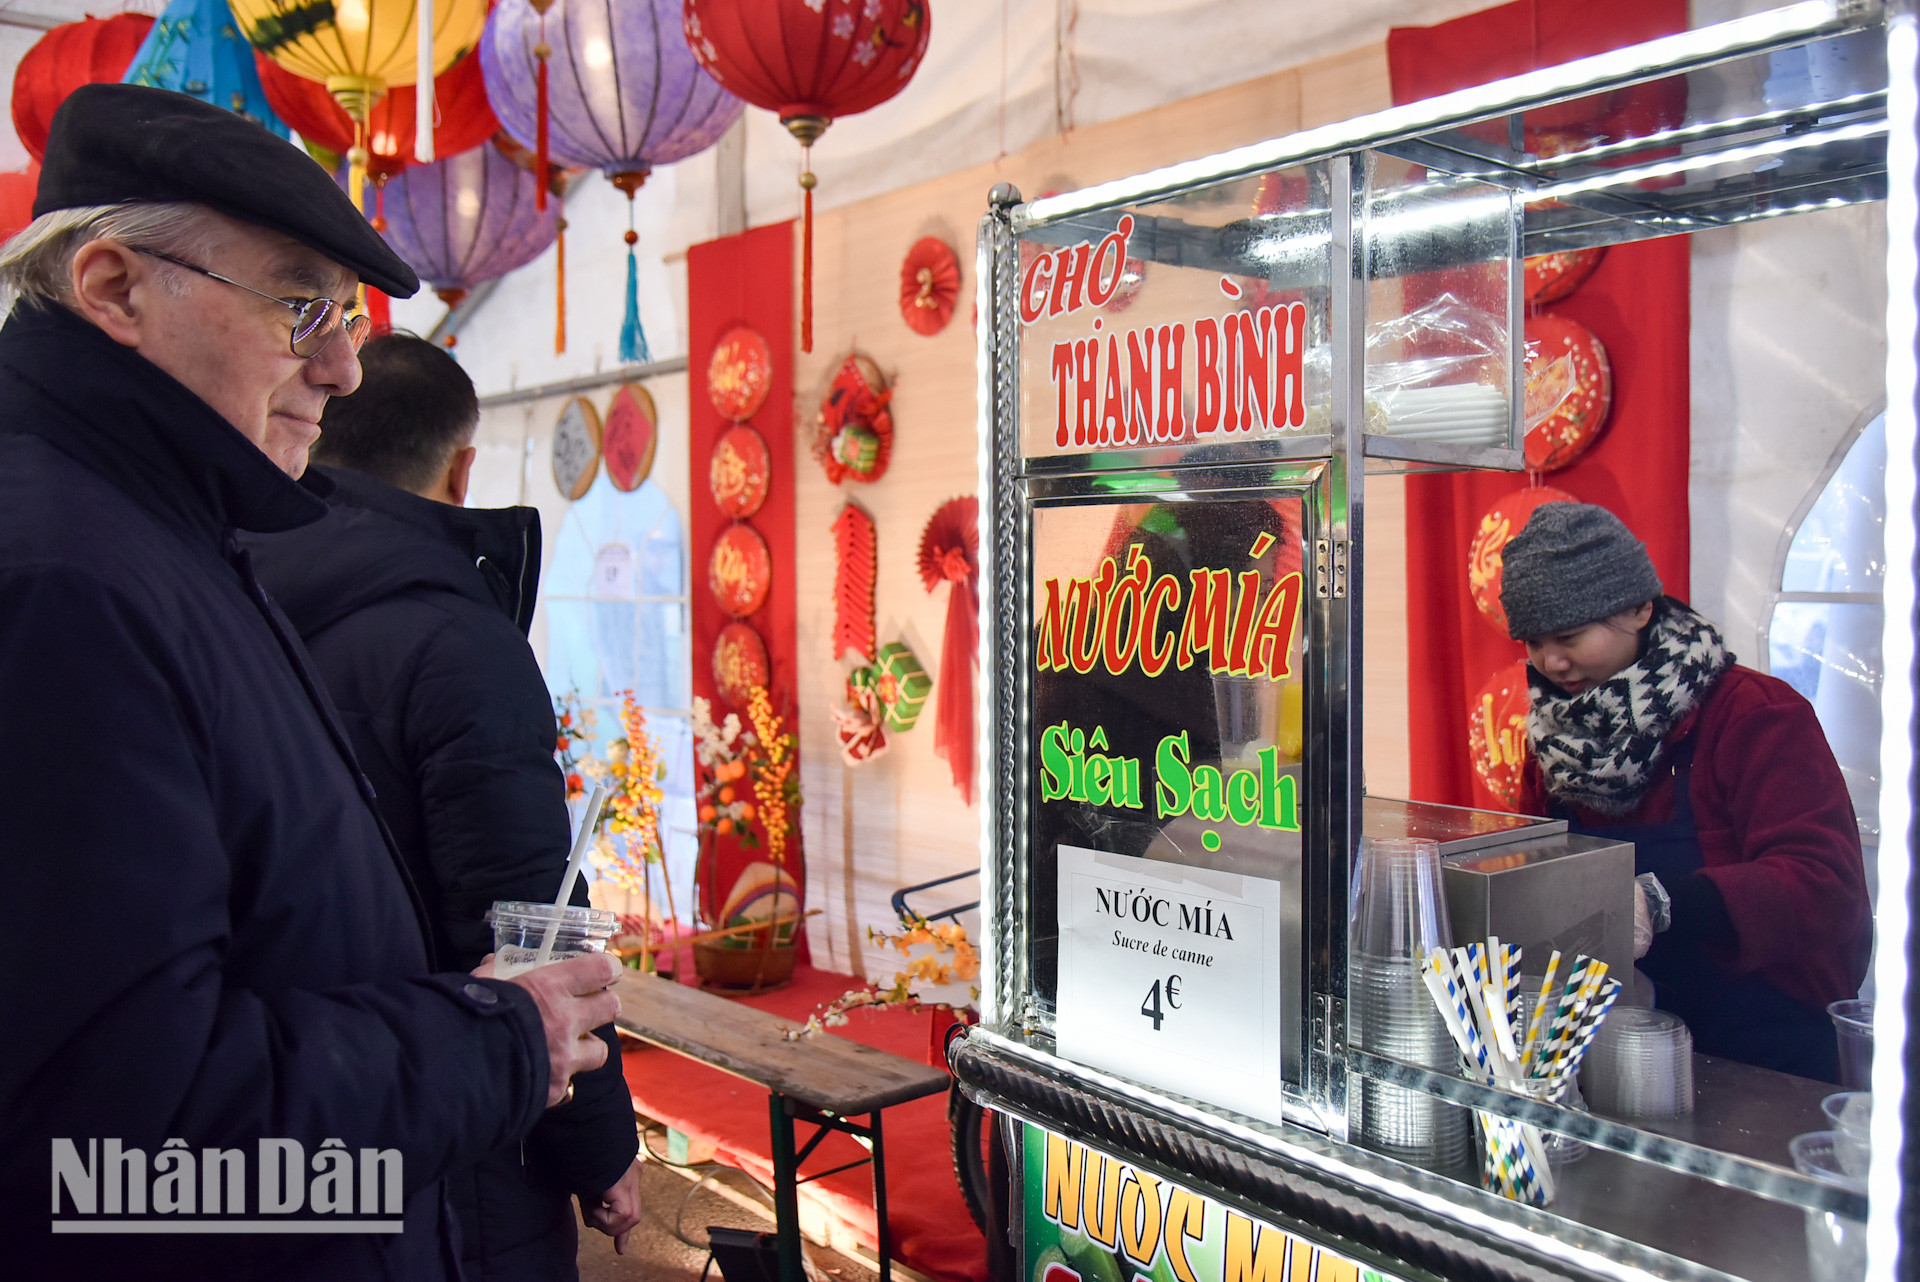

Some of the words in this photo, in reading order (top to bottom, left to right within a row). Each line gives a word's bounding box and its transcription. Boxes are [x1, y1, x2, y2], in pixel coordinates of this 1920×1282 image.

[1020, 214, 1134, 330] CHỢ
[1052, 323, 1186, 448] THANH
[1195, 275, 1308, 438] BÌNH
[1036, 543, 1181, 677] NƯỚC
[1176, 531, 1303, 681] MÍA
[1040, 720, 1143, 809] Siêu
[1155, 730, 1301, 852] Sạch
[1095, 887, 1170, 926] NƯỚC
[1178, 900, 1235, 941] MÍA
[1112, 930, 1150, 954] Sucre
[1152, 939, 1168, 957] de
[1172, 947, 1214, 967] canne
[1141, 974, 1183, 1032] 4€
